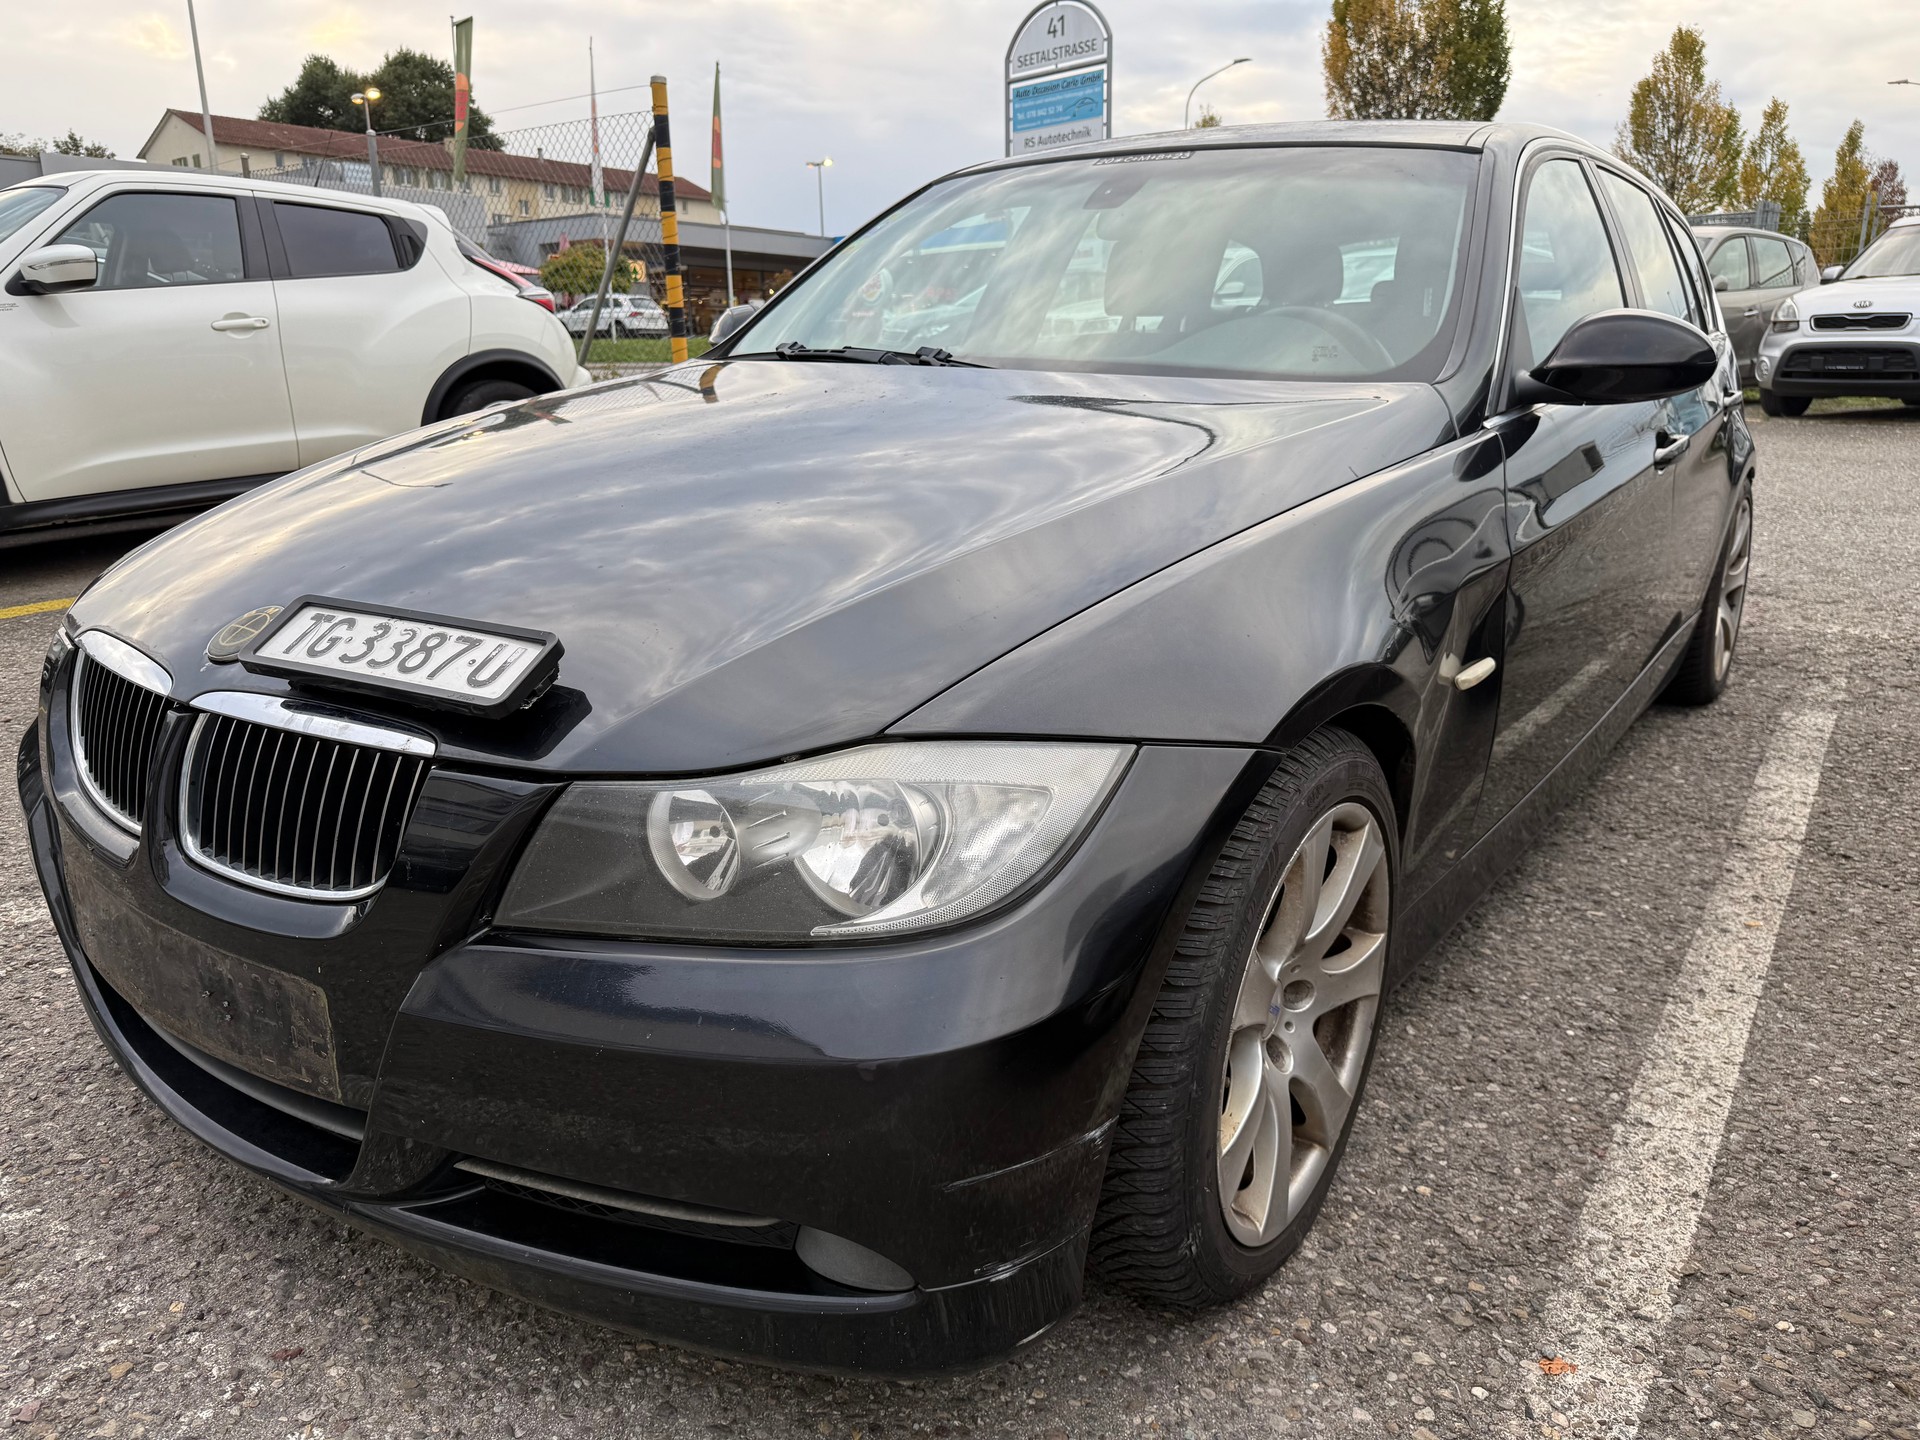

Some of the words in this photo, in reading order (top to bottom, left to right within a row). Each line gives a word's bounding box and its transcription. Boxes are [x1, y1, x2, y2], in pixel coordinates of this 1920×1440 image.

[1047, 14, 1065, 39] 41
[1017, 38, 1098, 69] SEETALSTRASSE
[1024, 137, 1036, 148] RS
[1037, 126, 1092, 146] Autotechnik
[1854, 300, 1872, 308] KIA
